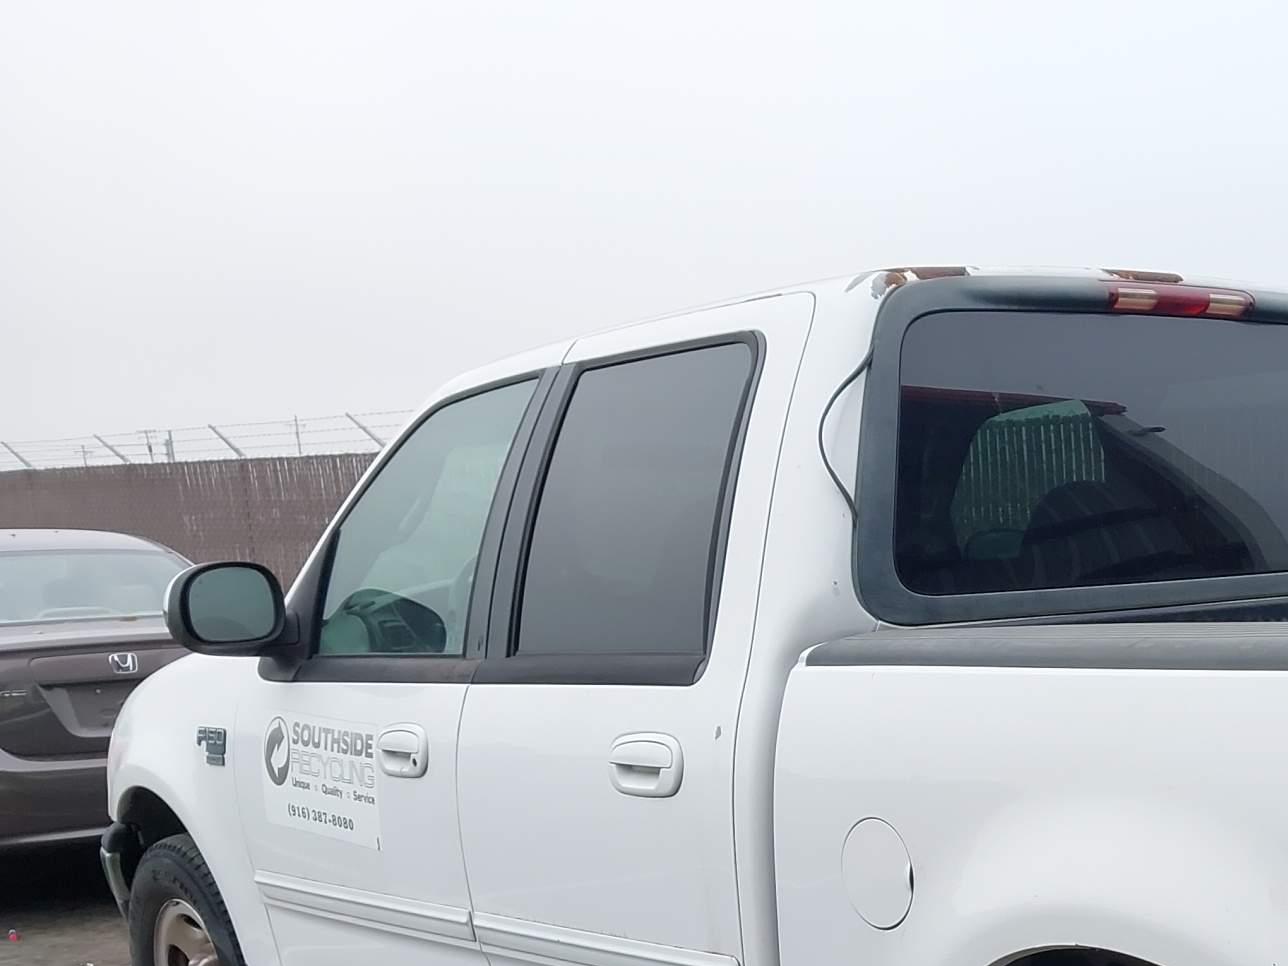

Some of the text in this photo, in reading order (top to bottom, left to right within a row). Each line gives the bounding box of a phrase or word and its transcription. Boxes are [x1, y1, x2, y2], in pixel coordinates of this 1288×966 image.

[291, 721, 374, 759] SOUTHSIDE
[290, 748, 376, 789] RECYCLING
[292, 776, 375, 805] Unique Quality Service
[287, 802, 354, 831] (916) 387-8080
